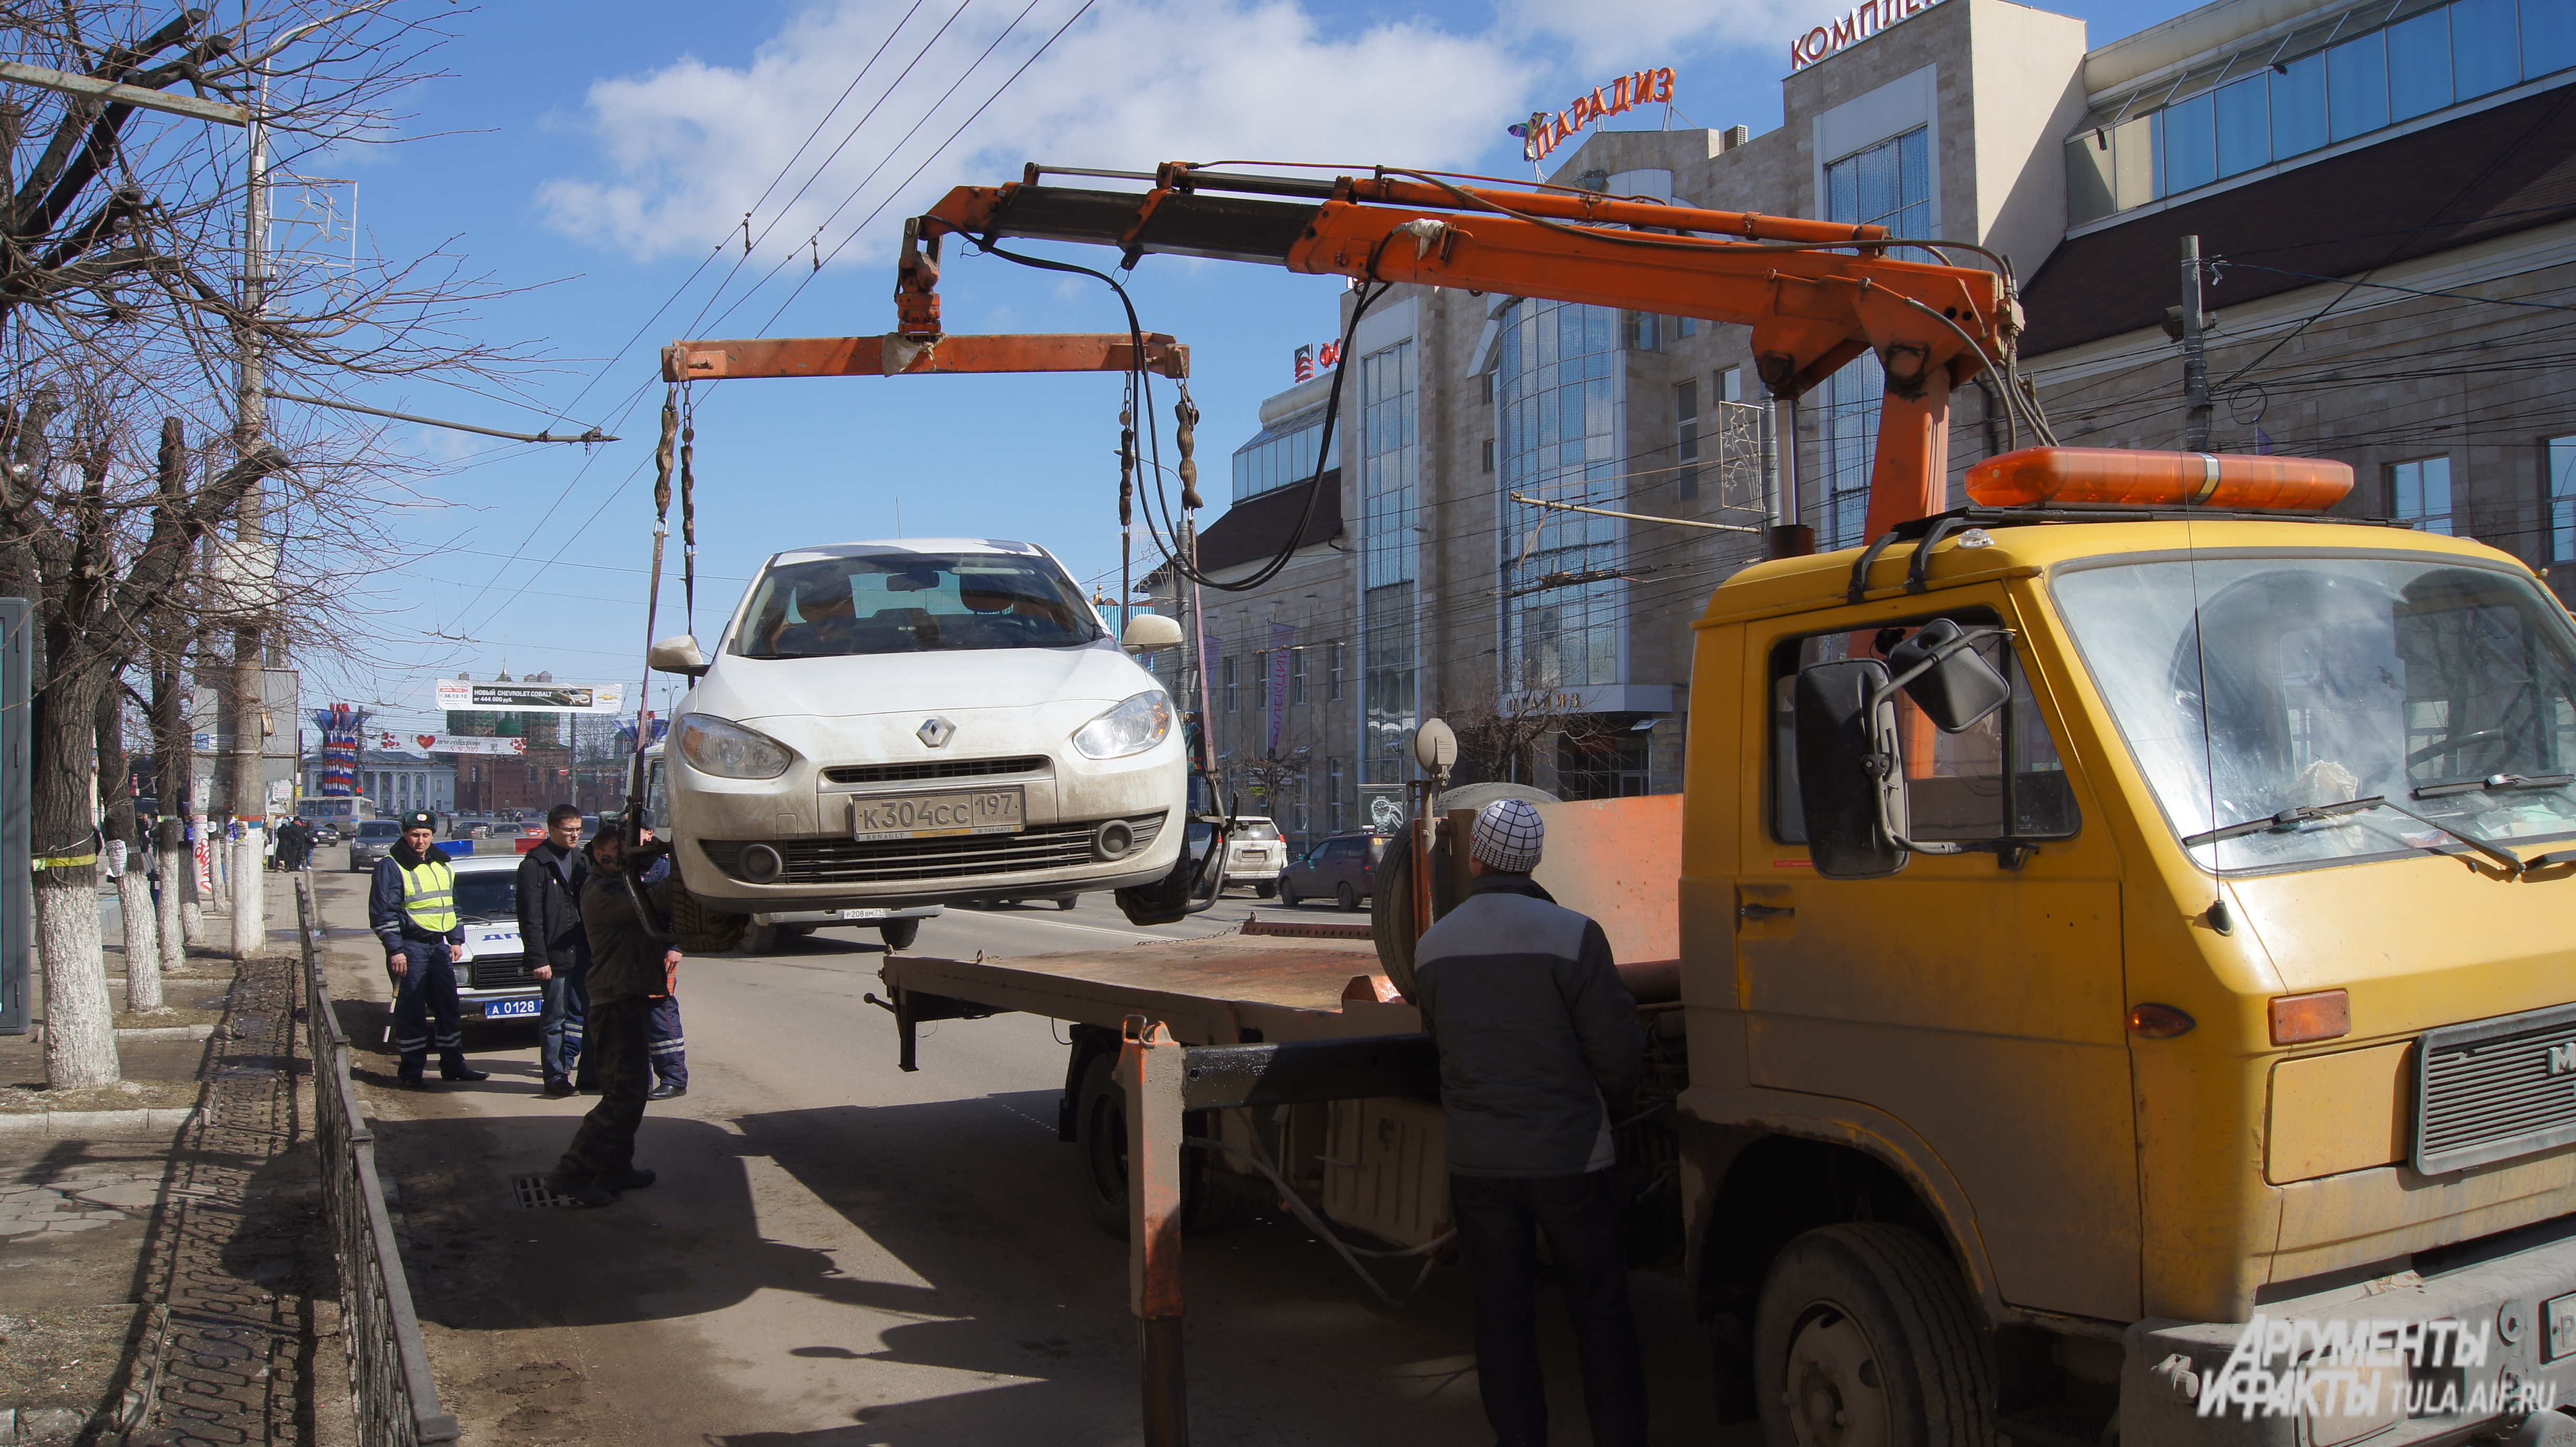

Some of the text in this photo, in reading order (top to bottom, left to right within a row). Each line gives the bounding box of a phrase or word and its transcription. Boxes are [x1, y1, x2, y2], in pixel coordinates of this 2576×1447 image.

[1791, 0, 1936, 70] КОМПЛ
[1535, 67, 1676, 160] ПАРАДИЗ
[1272, 646, 1289, 749] ОЛЛЕКЦИИ
[450, 738, 481, 747] collections
[974, 793, 1014, 815] 197
[984, 814, 1004, 823] RUS
[504, 1000, 535, 1014] 0128
